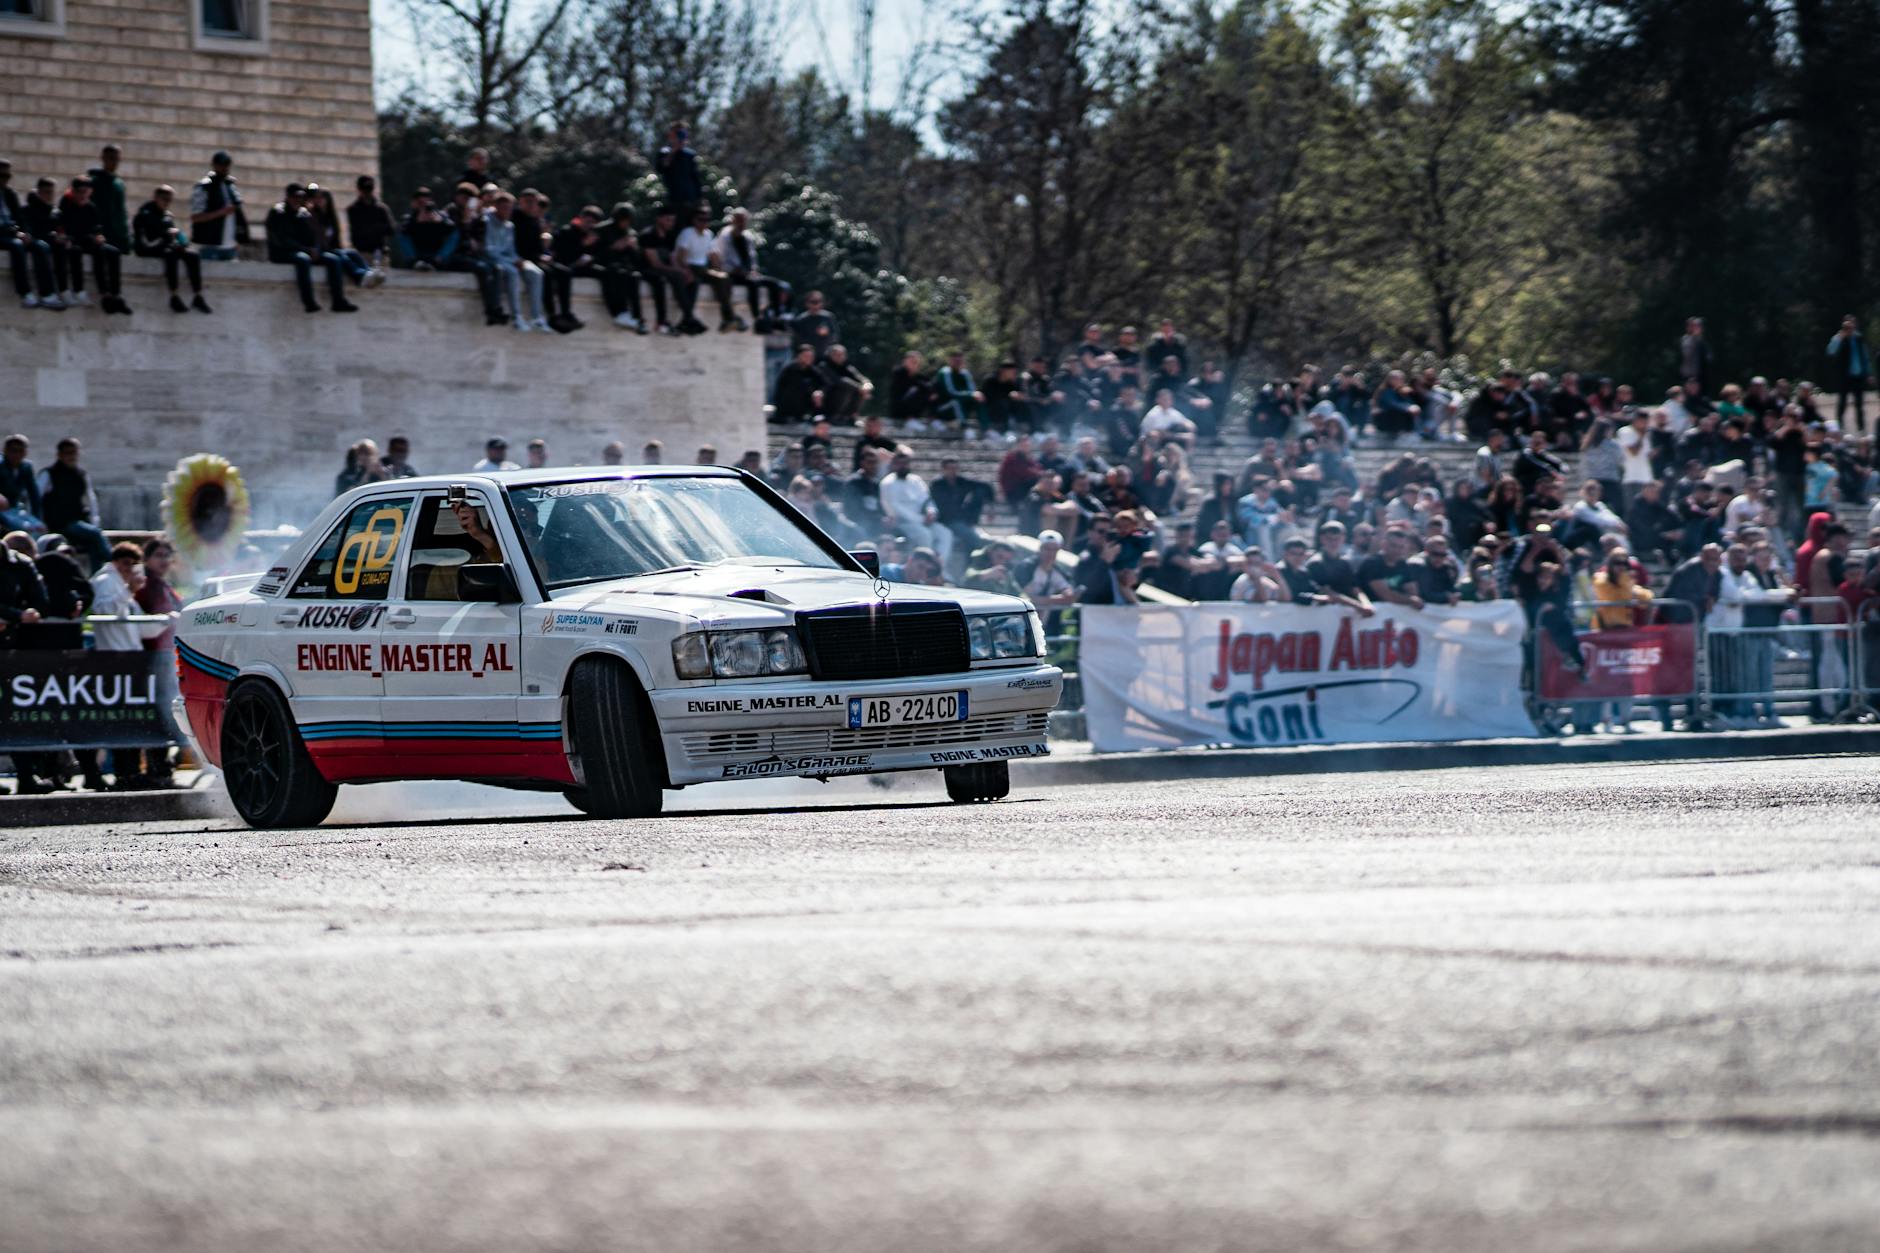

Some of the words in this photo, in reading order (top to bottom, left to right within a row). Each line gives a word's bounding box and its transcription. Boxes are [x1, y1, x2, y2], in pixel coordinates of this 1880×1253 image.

[556, 614, 578, 625] SUPER
[579, 615, 605, 626] SAIYAN
[297, 643, 513, 677] ENGINE_MASTER_AL
[1210, 618, 1321, 692] Japan
[1328, 615, 1419, 671] Auto
[11, 674, 157, 707] SAKULI
[12, 710, 51, 721] SIGN
[60, 710, 70, 721] &
[79, 709, 156, 721] PRINTING
[687, 695, 844, 713] ENGINE_MASTER_AL
[867, 700, 891, 723] AB
[1225, 686, 1325, 742] Goni
[930, 744, 1051, 762] ENGINE_MASTER_AL
